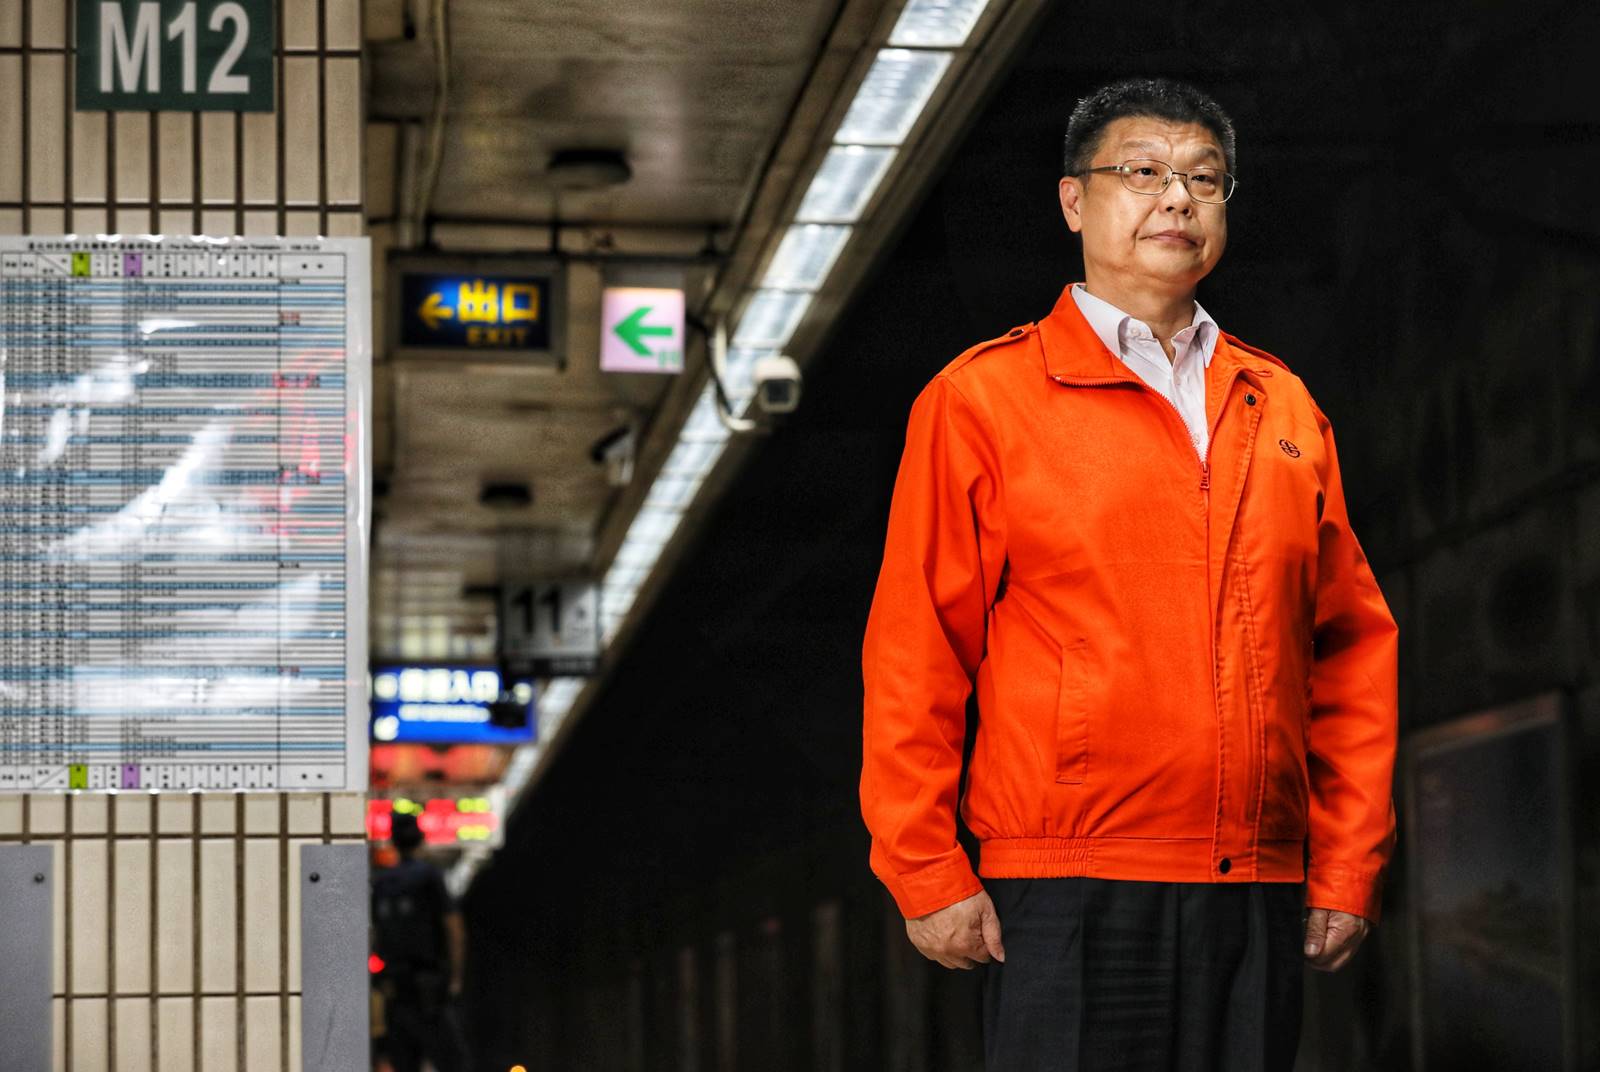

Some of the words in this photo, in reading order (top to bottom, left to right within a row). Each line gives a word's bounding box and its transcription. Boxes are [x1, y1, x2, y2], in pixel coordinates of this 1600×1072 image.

[99, 1, 249, 93] M12
[458, 280, 539, 322] 出口
[466, 327, 528, 344] EXIT
